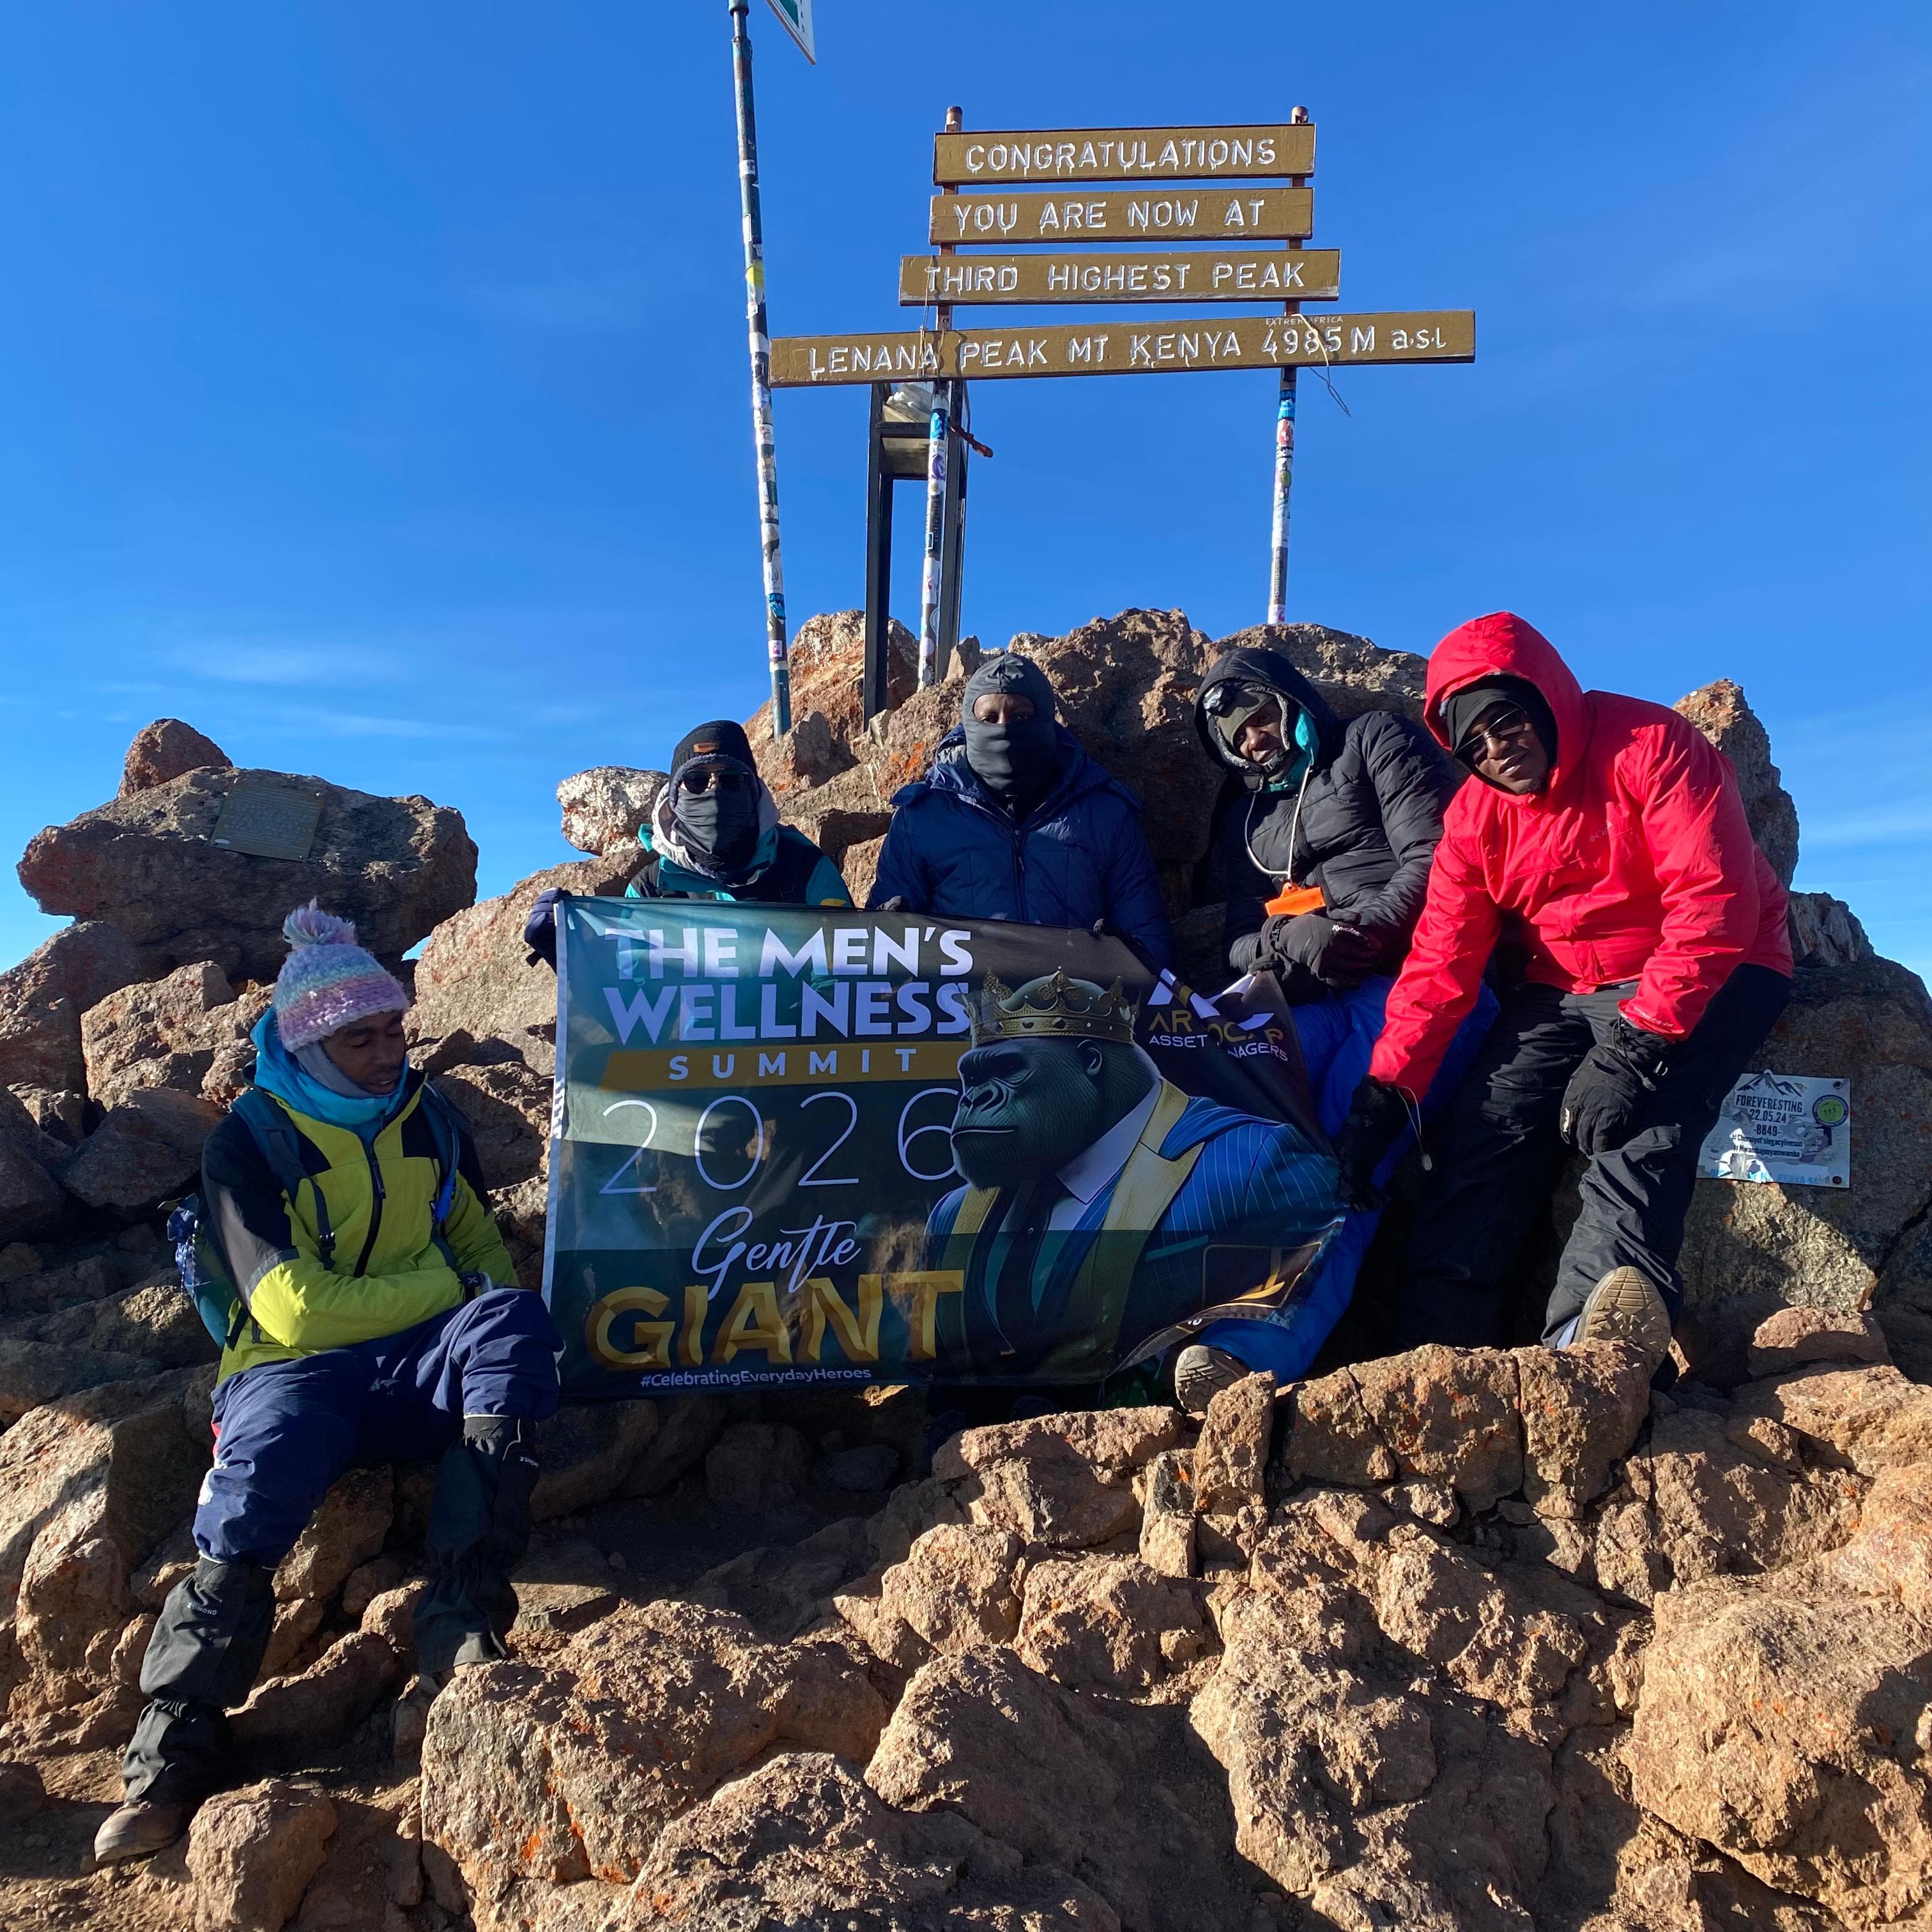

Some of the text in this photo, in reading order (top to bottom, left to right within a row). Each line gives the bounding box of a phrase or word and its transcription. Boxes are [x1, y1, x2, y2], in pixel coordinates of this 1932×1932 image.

[965, 138, 1276, 177] CONGRATULATIONS
[954, 199, 1265, 237] YOU ARE NOW AT
[924, 261, 1305, 295] THIRD HIGHEST PEAK
[809, 346, 938, 376] LENANA
[960, 339, 1048, 369] PEAK
[1128, 330, 1241, 364] KENYA
[1261, 326, 1342, 358] 4985
[1350, 325, 1376, 354] M
[604, 926, 974, 979] THE MEN'S
[603, 982, 972, 1045] WELLNESS
[1149, 1034, 1208, 1048] ASSET
[669, 1048, 917, 1080] SUMMIT
[1736, 1094, 1803, 1113] FOREVERESTING
[1749, 1108, 1787, 1124] 22.05.24
[599, 1087, 960, 1195] 2026
[691, 1206, 862, 1301] Gentle
[584, 1269, 965, 1370] GIANT
[640, 1366, 871, 1388] #CelebratingEverydayHeroes
